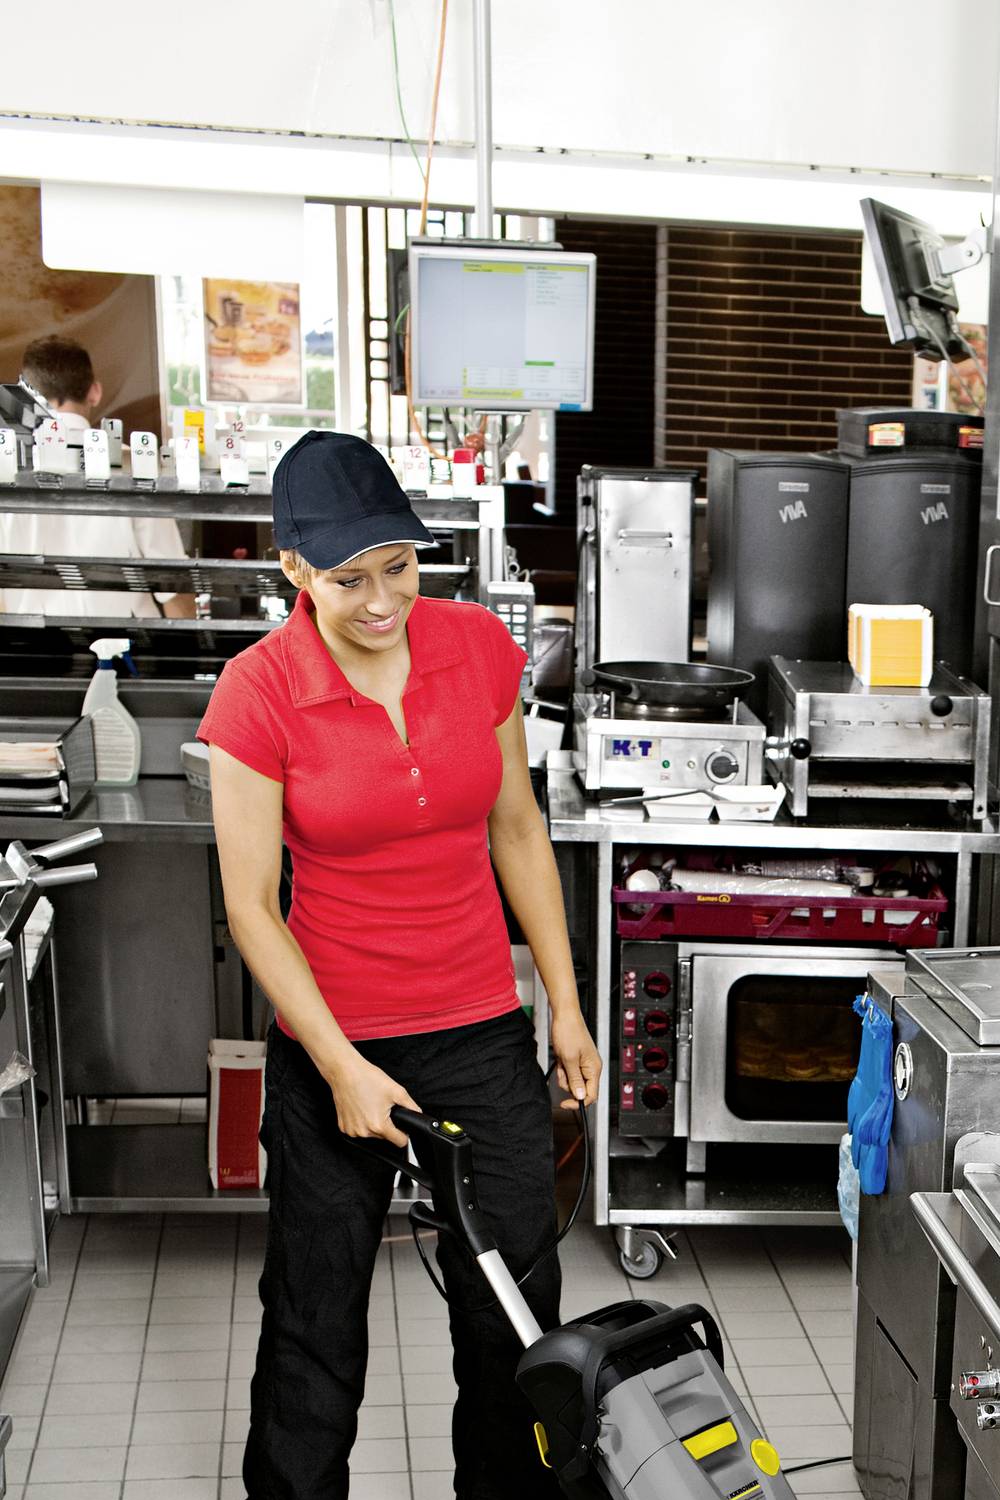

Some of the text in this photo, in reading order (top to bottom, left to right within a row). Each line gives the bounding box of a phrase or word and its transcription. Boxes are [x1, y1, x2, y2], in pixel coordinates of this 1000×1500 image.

[50, 421, 58, 431] 4
[109, 421, 114, 431] 1
[232, 422, 244, 432] 12
[91, 431, 99, 442] 5
[141, 434, 149, 445] 6
[226, 438, 234, 449] 8
[274, 440, 282, 451] 9
[409, 448, 421, 458] 12
[779, 500, 807, 523] VIVA
[921, 502, 949, 524] VIVA
[613, 740, 652, 756] K+T
